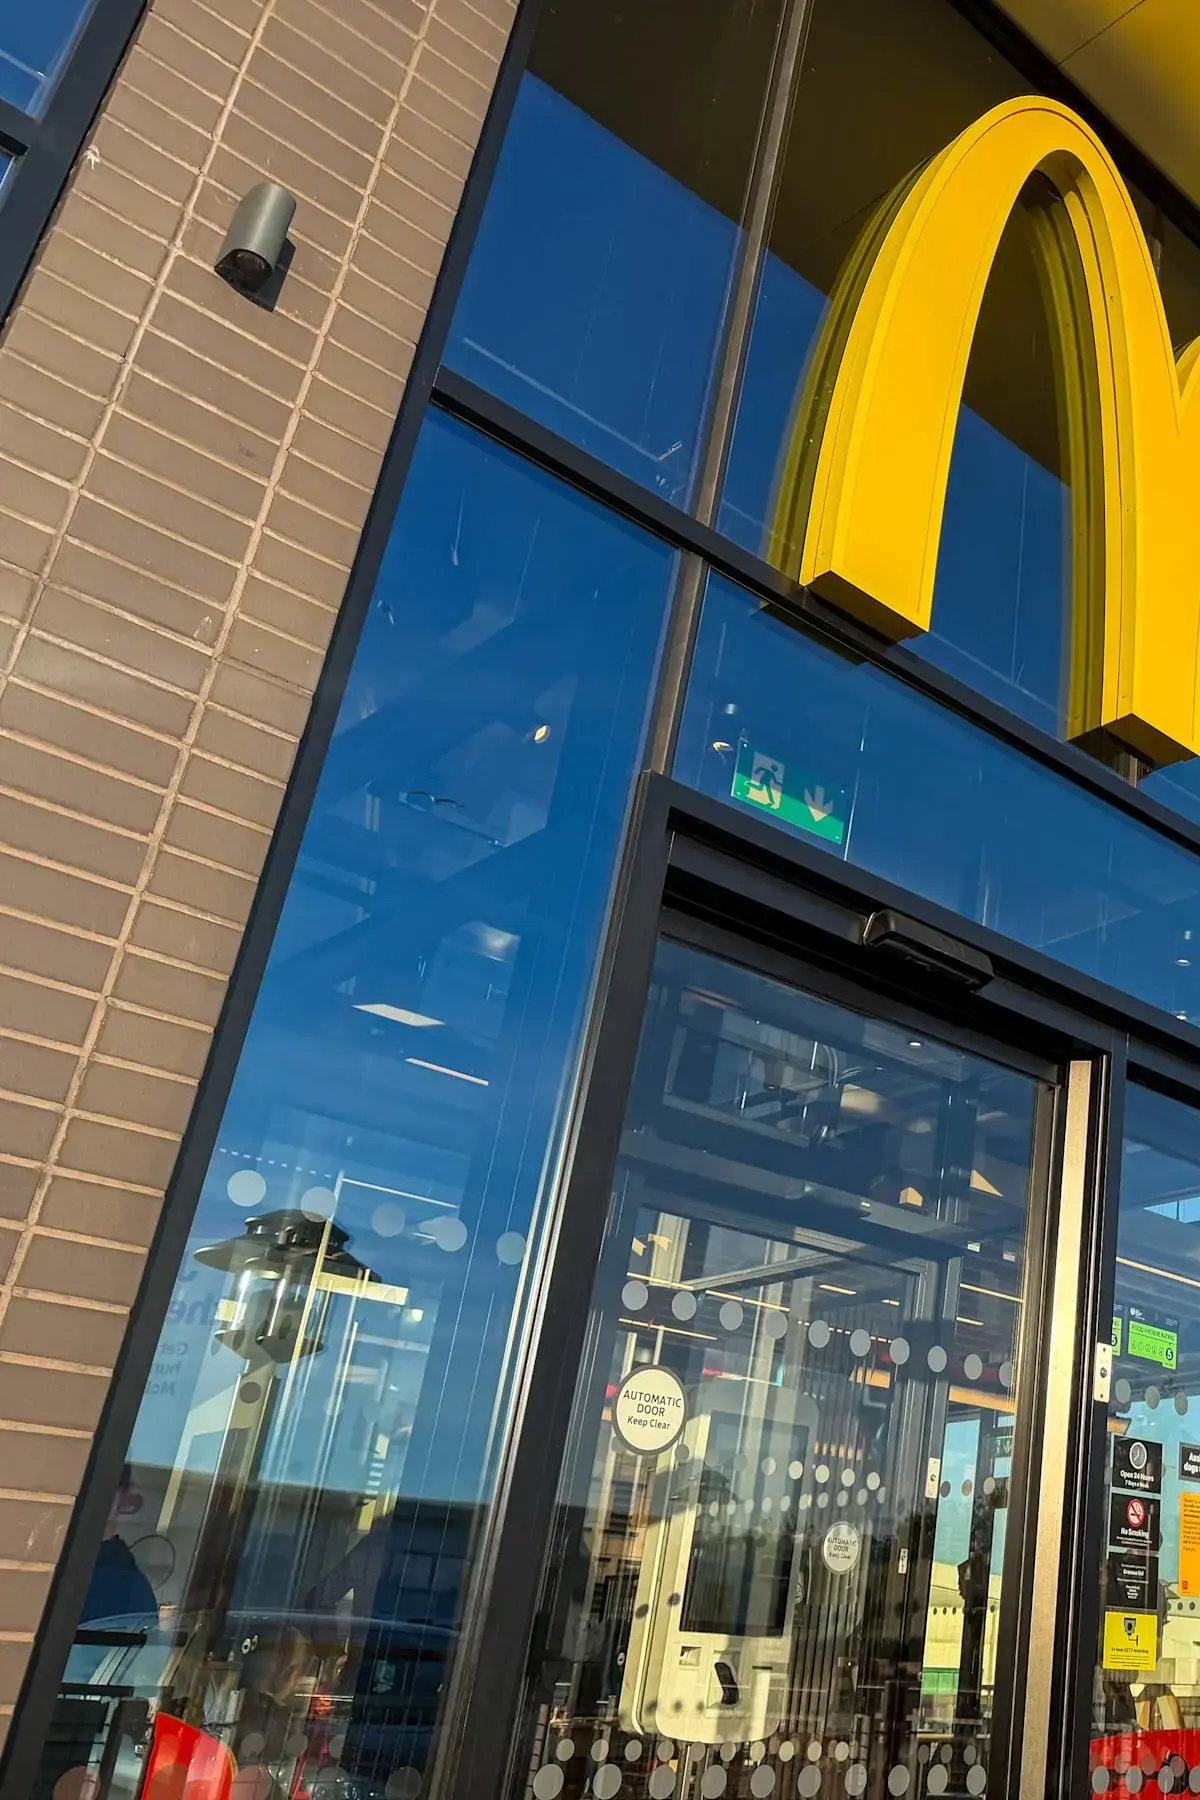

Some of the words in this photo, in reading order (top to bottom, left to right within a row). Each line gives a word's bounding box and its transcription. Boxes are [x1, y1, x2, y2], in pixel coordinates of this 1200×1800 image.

[623, 1389, 682, 1408] AUTOMATIC
[637, 1403, 666, 1417] DOOR
[627, 1415, 648, 1428] Keep
[649, 1419, 671, 1430] Clear
[1183, 1461, 1199, 1475] dogs
[1120, 1469, 1134, 1480] Open
[1133, 1472, 1141, 1480] 24
[1140, 1473, 1155, 1482] Hours
[1120, 1527, 1129, 1536] No
[1128, 1528, 1149, 1540] Smoking
